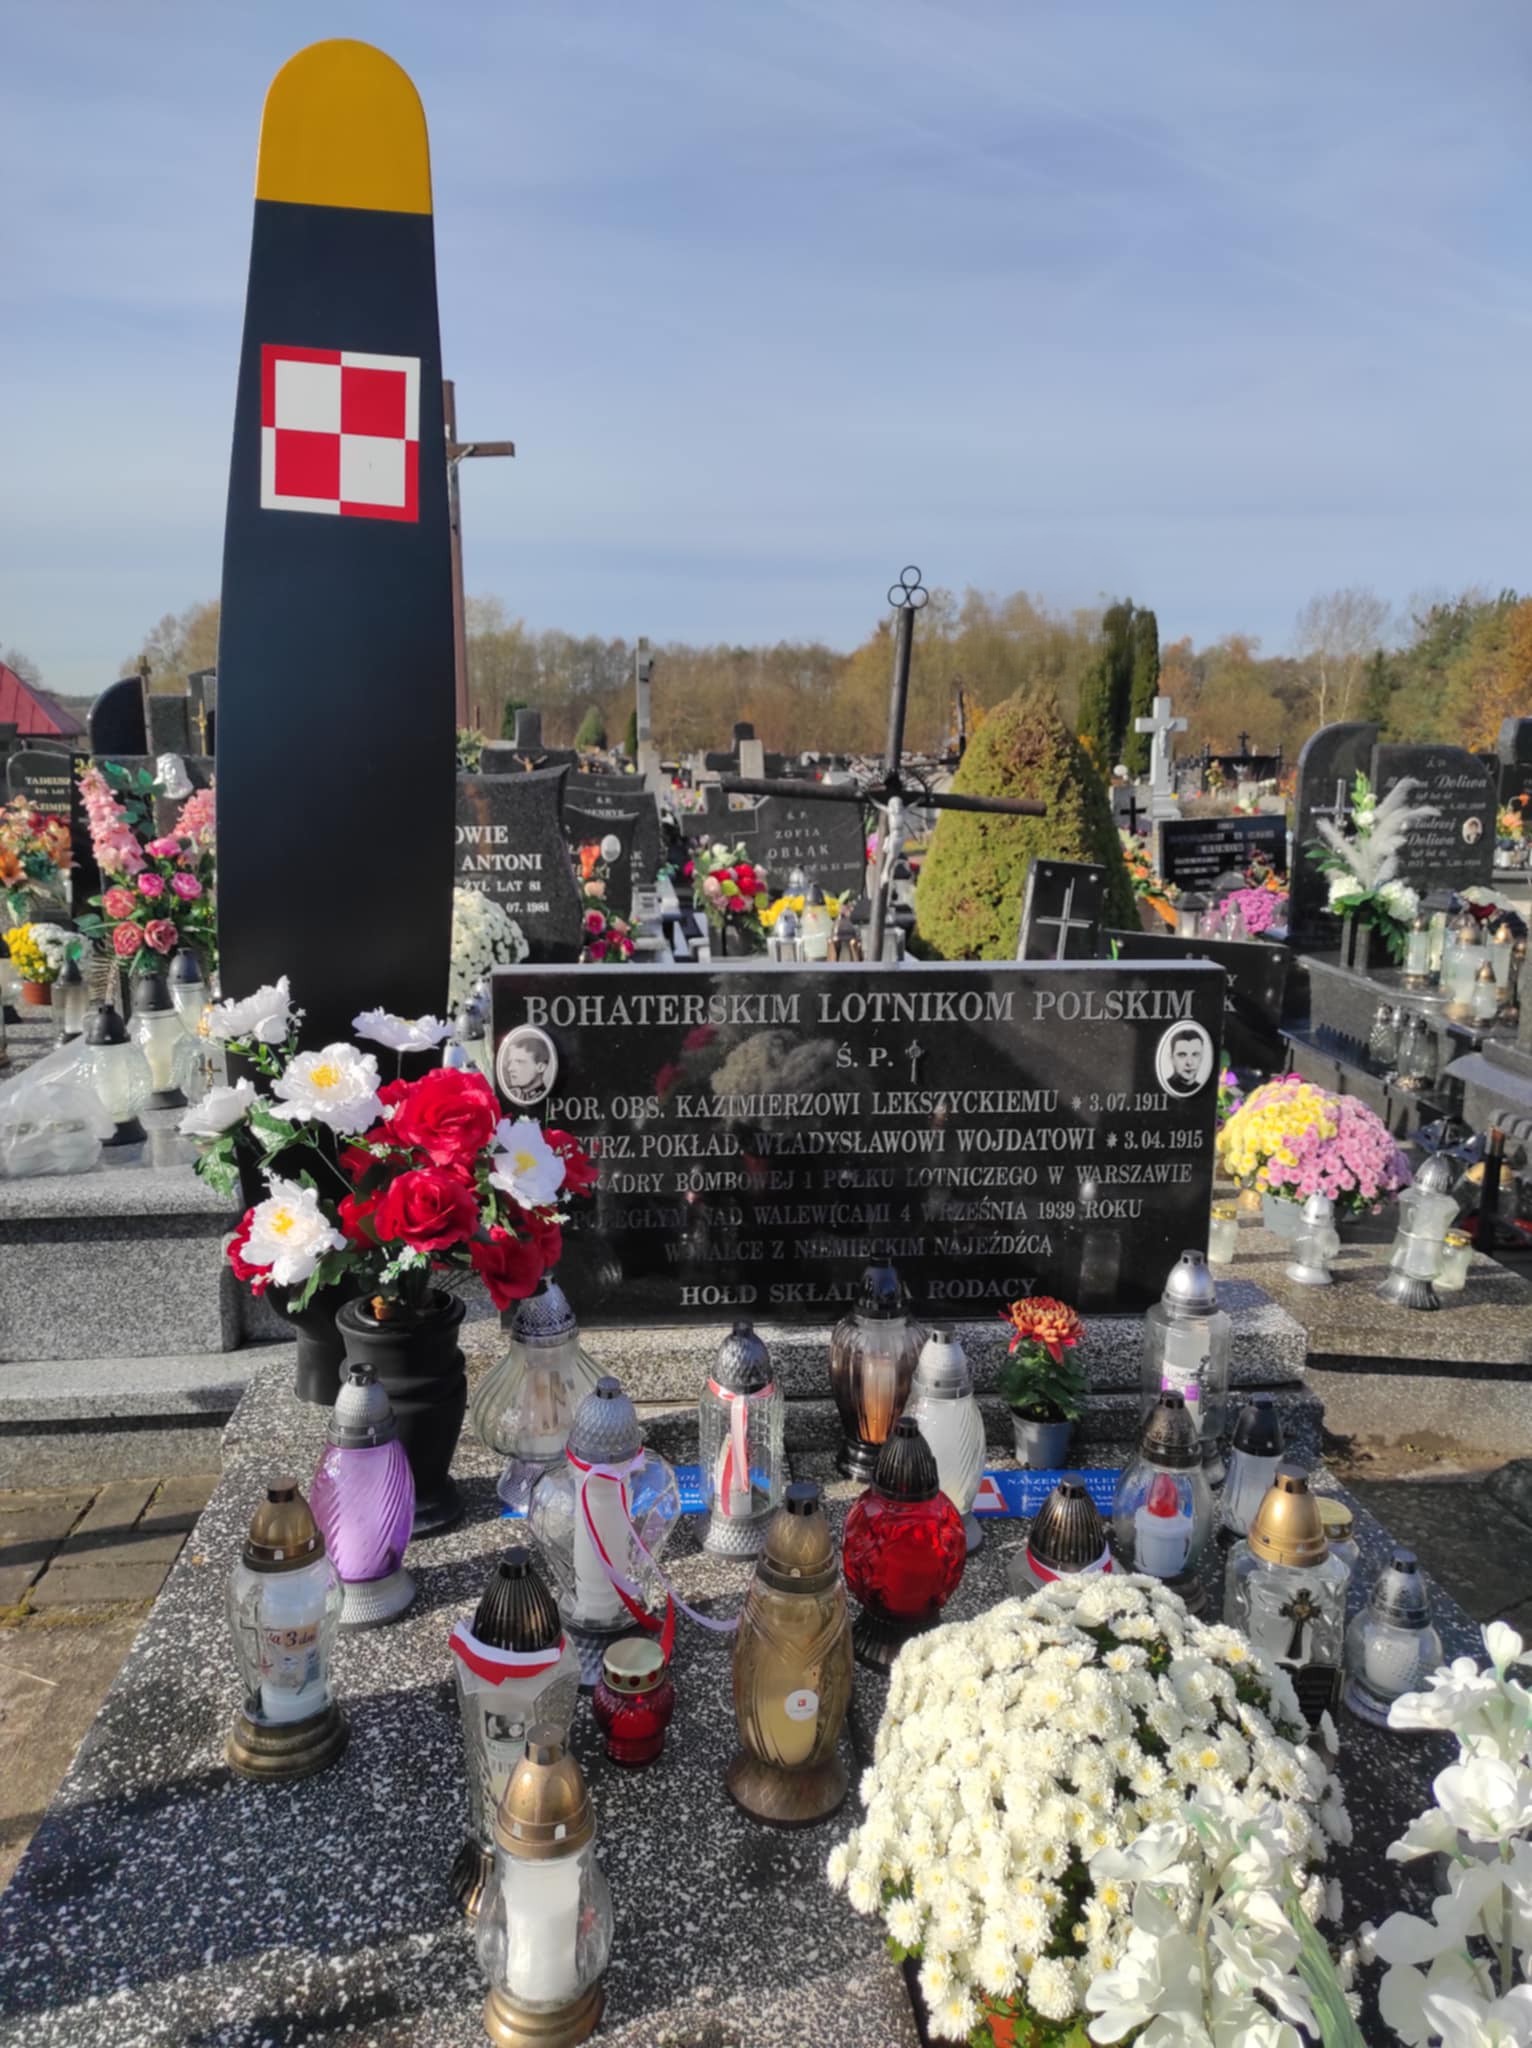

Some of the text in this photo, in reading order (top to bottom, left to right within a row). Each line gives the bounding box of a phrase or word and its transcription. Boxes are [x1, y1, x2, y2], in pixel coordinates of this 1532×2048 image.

[461, 853, 543, 872] ANTONI
[496, 880, 524, 893] LAT
[523, 993, 801, 1027] BOHATERSKIM
[817, 991, 1015, 1024] LOTNIKOM
[1032, 989, 1196, 1021] POLSKIM
[548, 1097, 606, 1121] POR.
[611, 1095, 665, 1120] OBS.
[675, 1092, 860, 1119] KAZIMIERZOWI
[871, 1089, 1058, 1115] LEKSZYCKIEMU
[640, 1133, 744, 1158] POKŁAD.
[753, 1130, 945, 1155] WŁADYSŁAWOWI
[956, 1128, 1096, 1151] WOJDATOWI
[674, 1168, 795, 1194] BOMBOWEJ
[905, 1166, 1038, 1187] LOTNICZEGO
[1047, 1165, 1065, 1185] W
[1075, 1163, 1193, 1184] WARSZAWIE
[900, 1203, 911, 1221] 4
[920, 1195, 1028, 1222] WRZEŚNIA
[1038, 1201, 1076, 1220] 1939
[1085, 1199, 1144, 1219] ROKU
[679, 1284, 758, 1305] HOŁD
[927, 1278, 1038, 1300] RODACY
